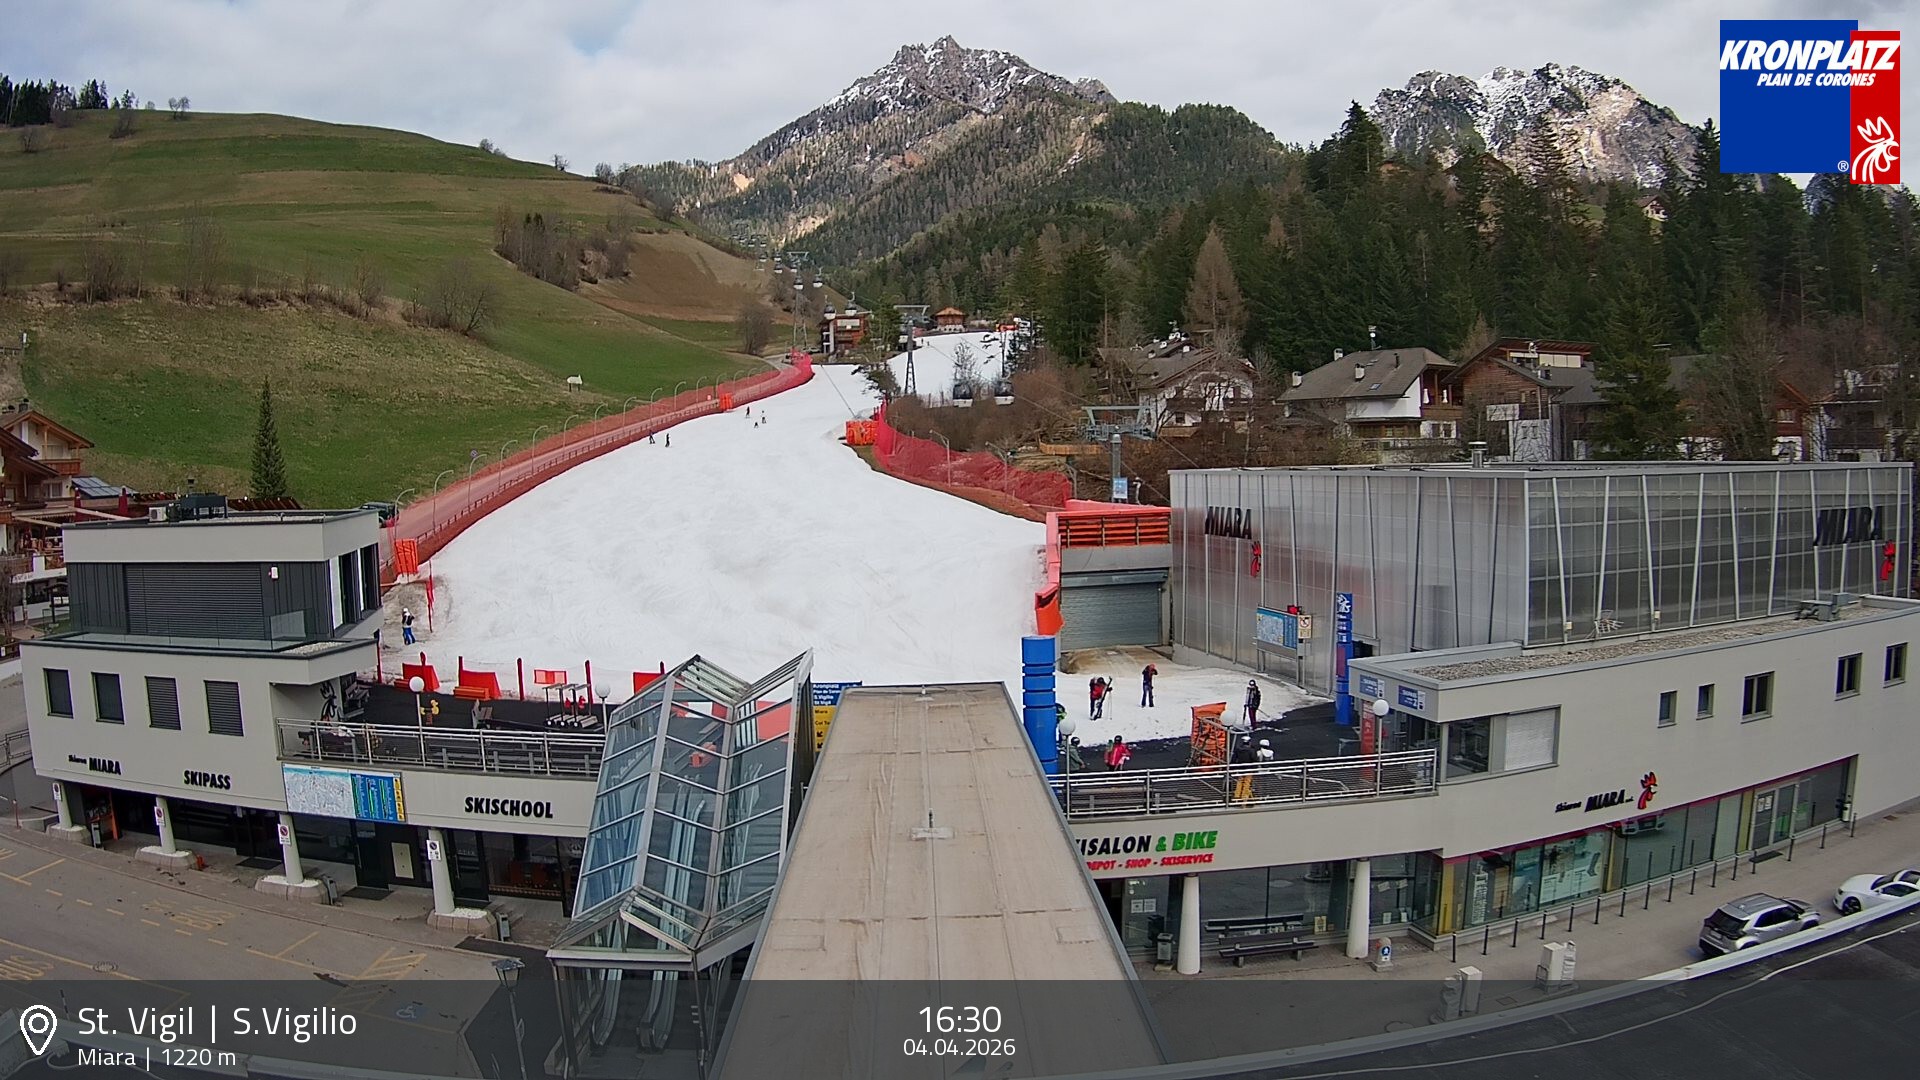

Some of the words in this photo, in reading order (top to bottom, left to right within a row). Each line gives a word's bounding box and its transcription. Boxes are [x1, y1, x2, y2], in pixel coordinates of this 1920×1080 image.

[1205, 506, 1252, 539] MIARA
[1813, 506, 1883, 546] MIARA
[89, 757, 121, 775] MIARA
[184, 770, 231, 790] SKIPASS
[465, 797, 553, 819] SKISCHOOL
[1585, 789, 1625, 812] MIARA
[1076, 835, 1151, 856] ISALON
[1156, 836, 1167, 852] &
[1172, 831, 1218, 851] BIKE
[1125, 858, 1152, 869] SHOP
[1160, 853, 1214, 867] SKISERVICE
[170, 905, 233, 931] BUS
